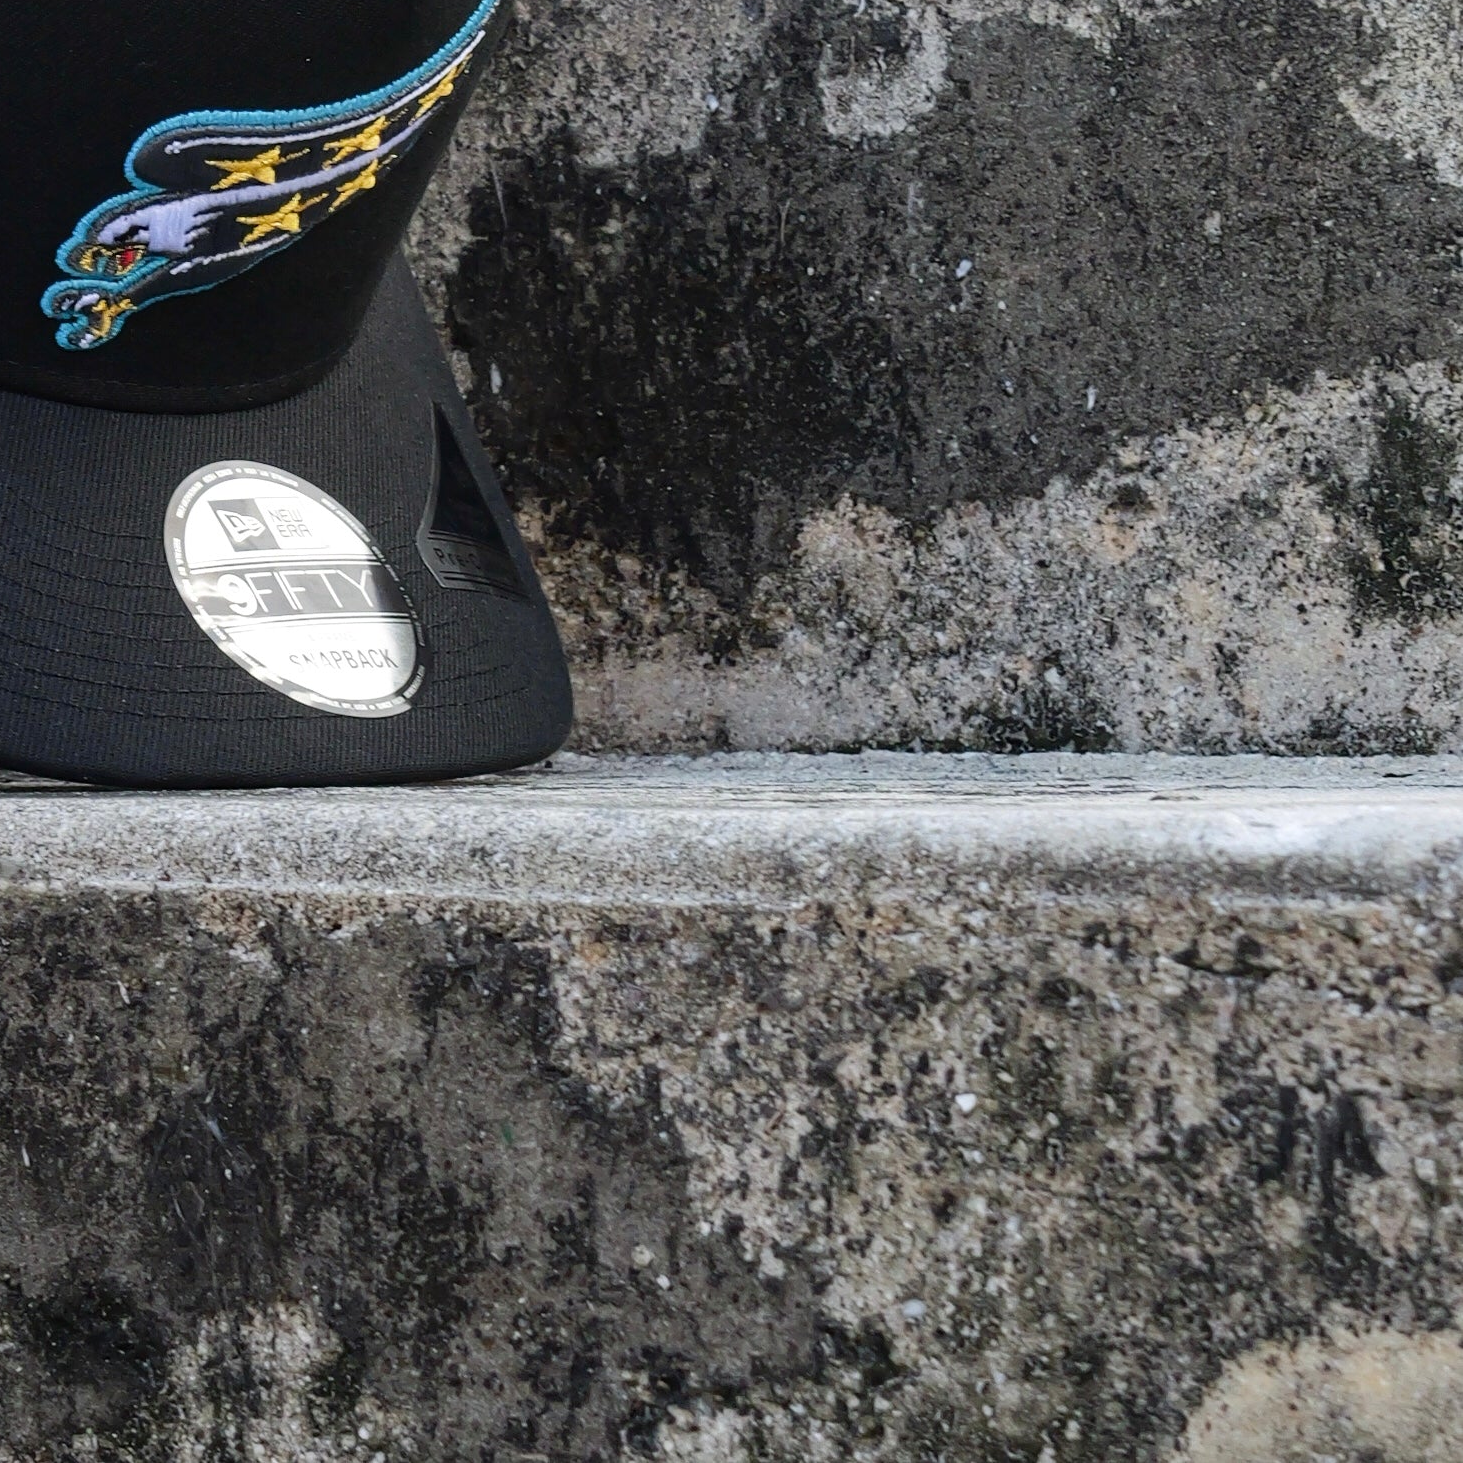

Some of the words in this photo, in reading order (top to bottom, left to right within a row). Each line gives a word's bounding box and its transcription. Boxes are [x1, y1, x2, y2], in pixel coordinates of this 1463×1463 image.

[266, 509, 305, 523] NEW
[277, 524, 312, 538] ERA
[217, 569, 373, 616] 9FIFTY
[289, 648, 398, 673] SNAPBACK
